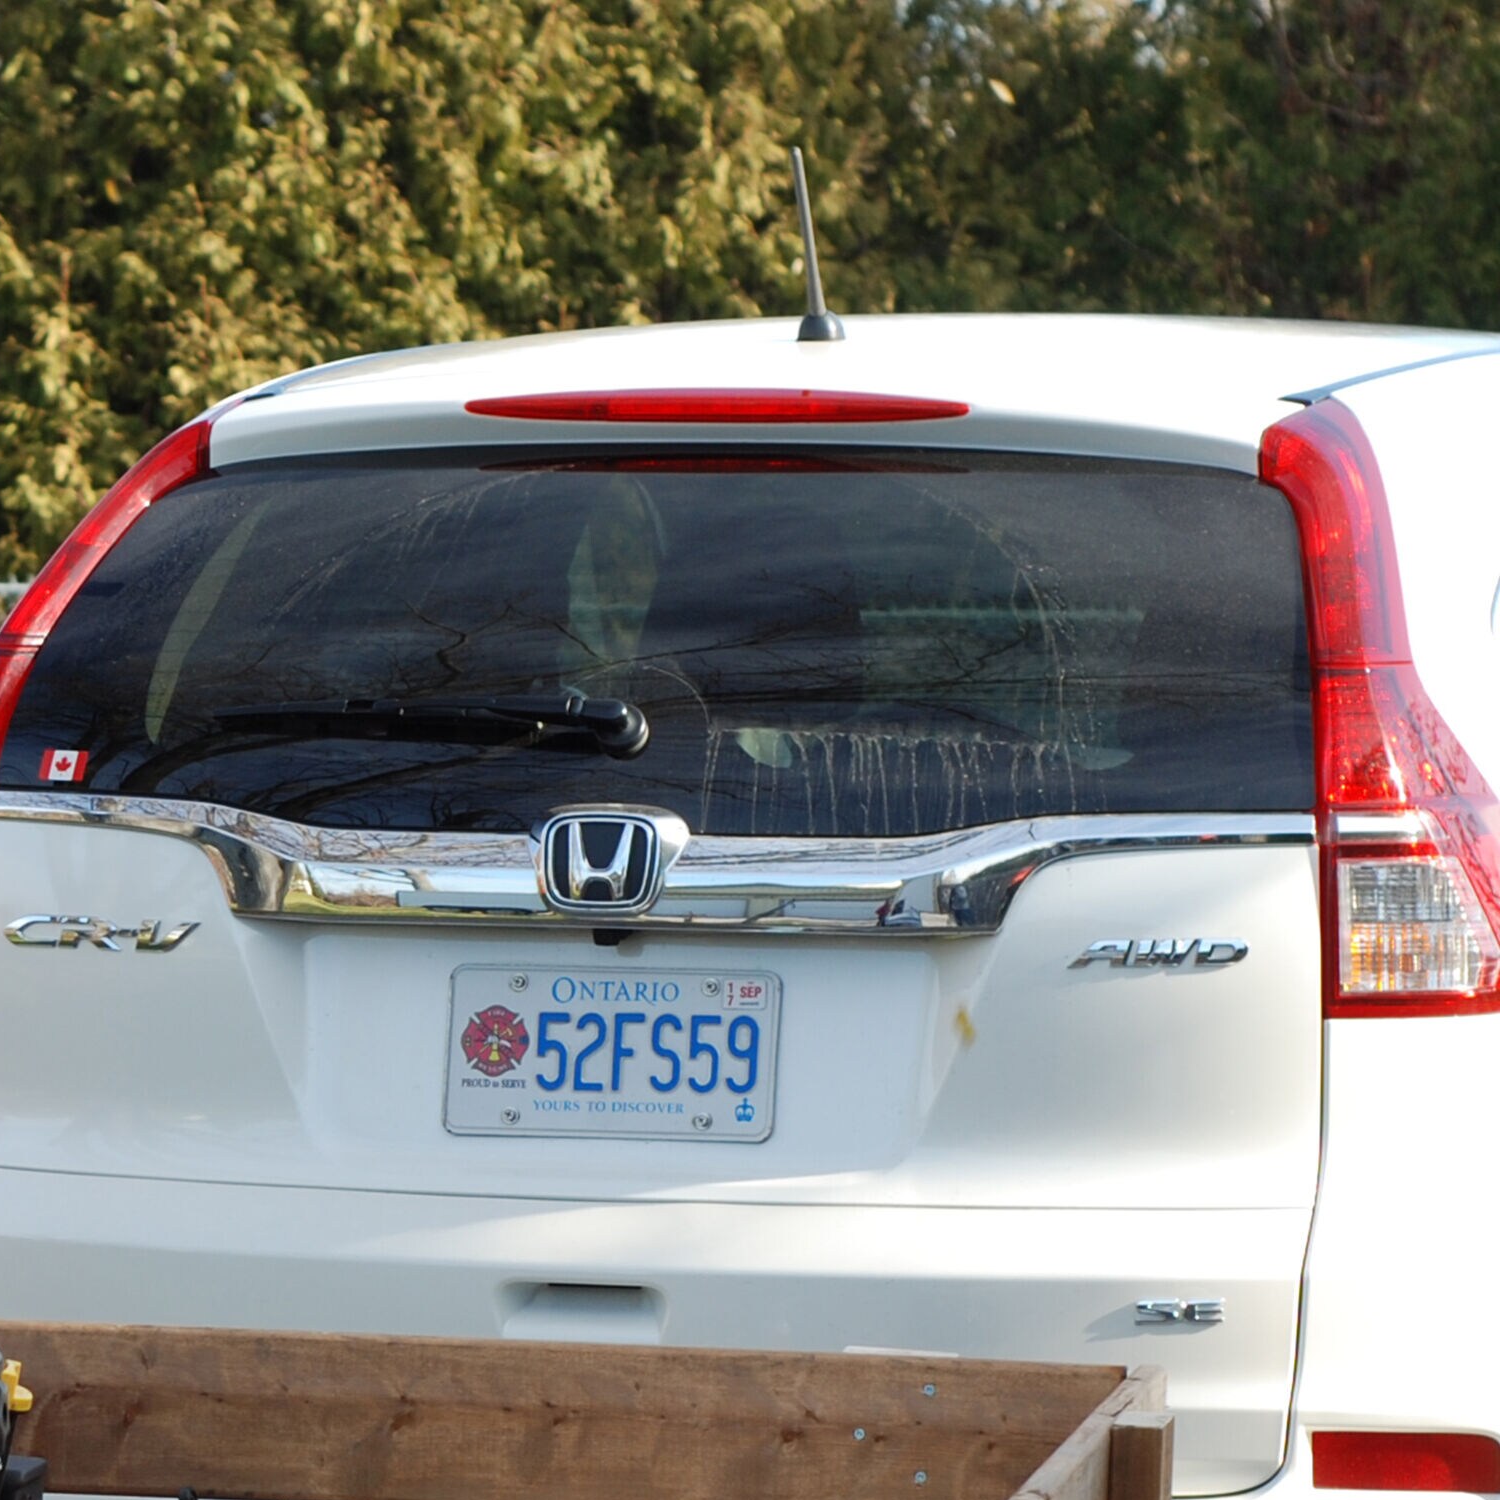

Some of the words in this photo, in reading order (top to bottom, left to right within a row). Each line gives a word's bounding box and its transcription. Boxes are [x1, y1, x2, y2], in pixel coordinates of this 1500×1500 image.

[3, 914, 201, 952] CR-V
[1067, 937, 1250, 969] AWD
[551, 976, 680, 1006] ONTARIO
[740, 985, 762, 998] SEP
[536, 1012, 760, 1093] 52FS59
[461, 1078, 491, 1088] PROUD
[501, 1079, 527, 1089] SERVE
[532, 1100, 580, 1112] YOURS
[587, 1101, 606, 1112] TO
[612, 1101, 685, 1114] DISCOVER
[1135, 1298, 1226, 1325] SE
